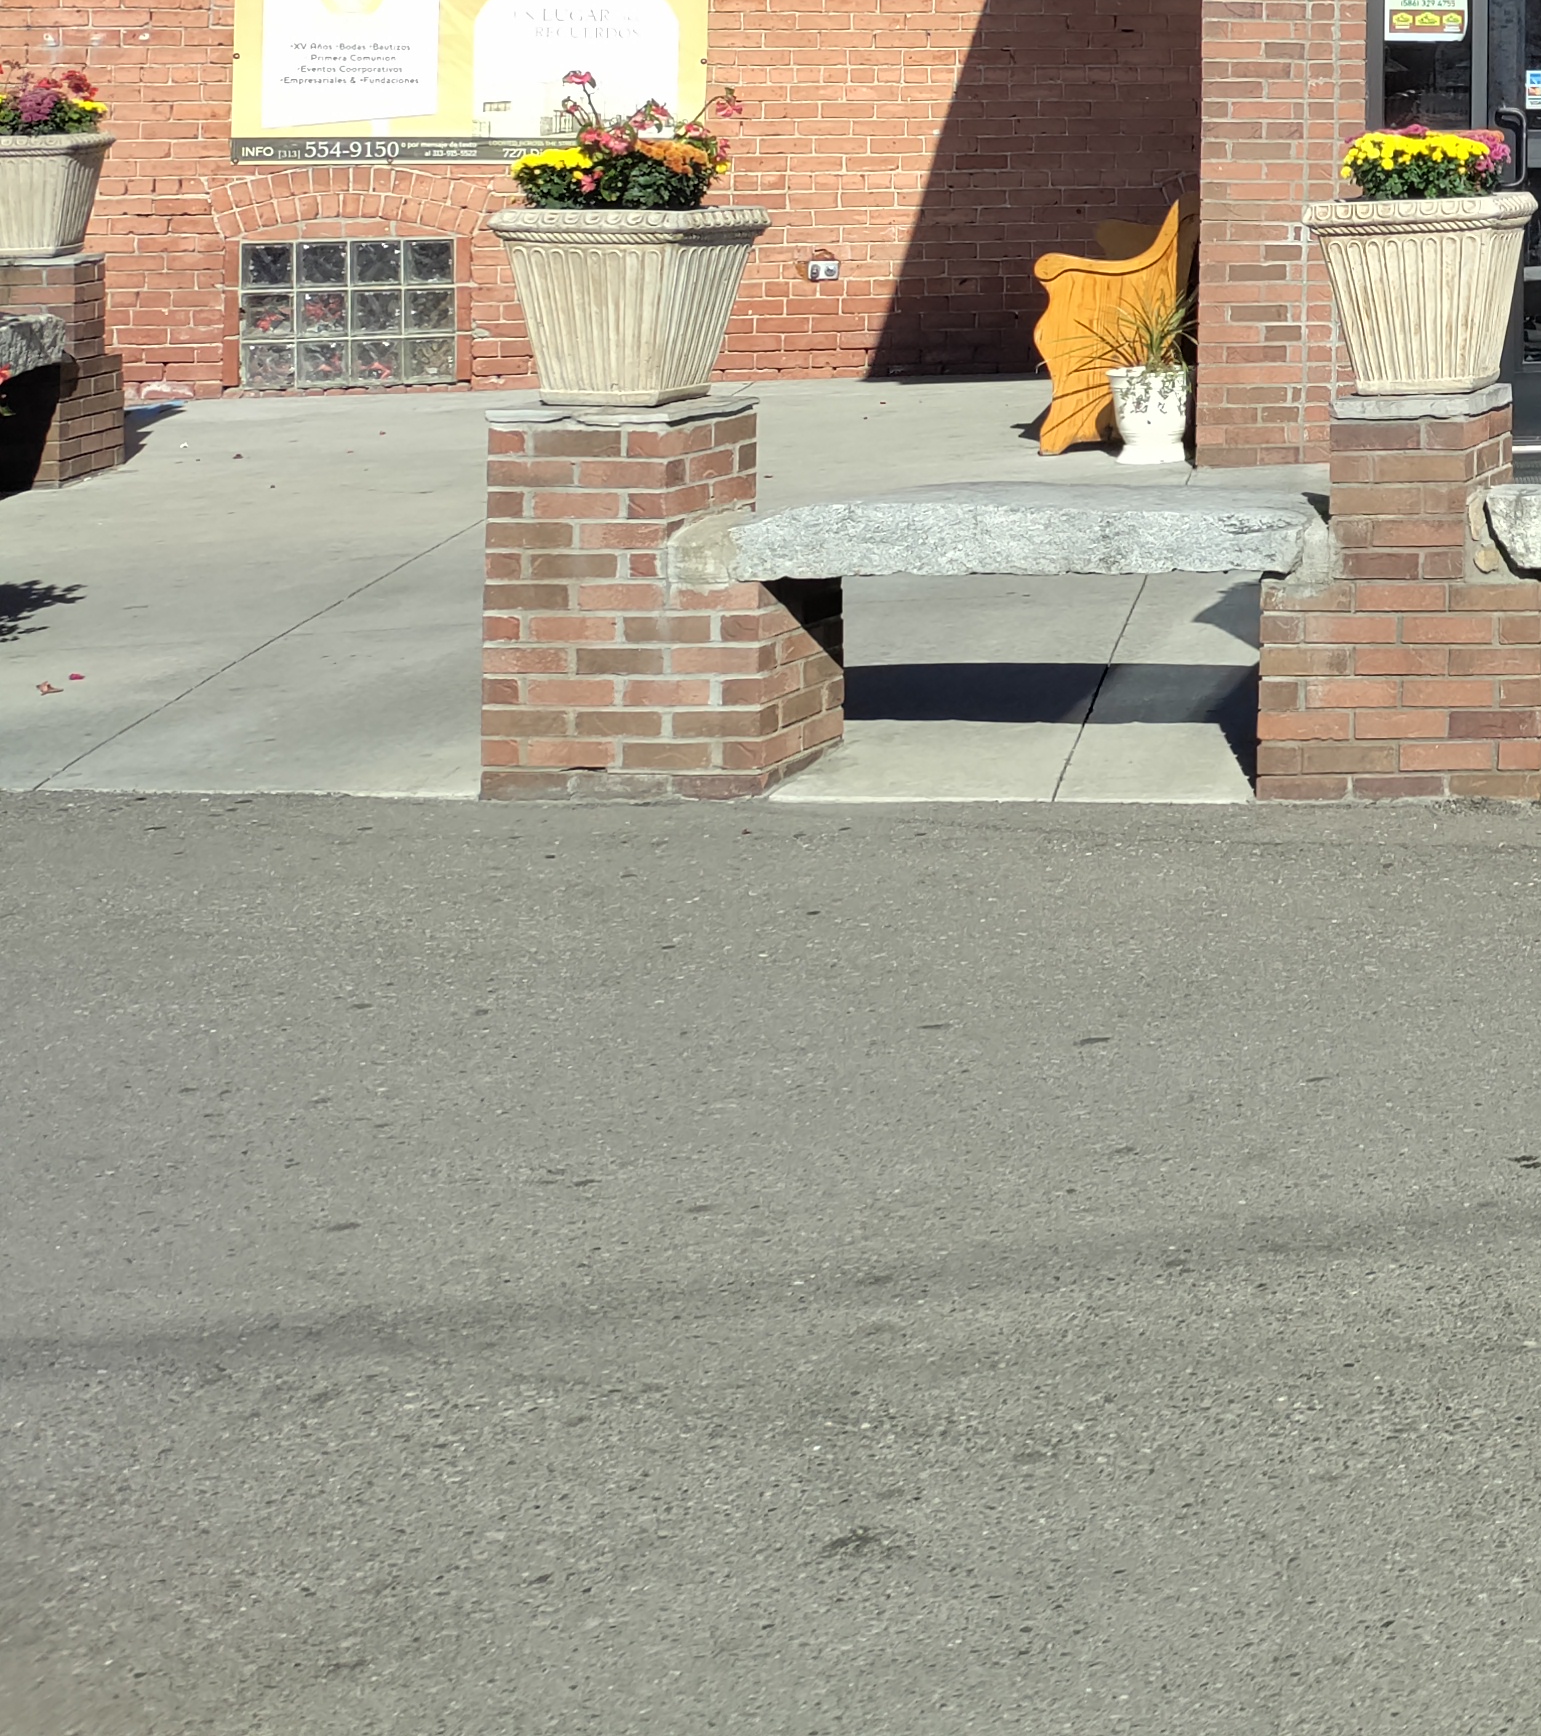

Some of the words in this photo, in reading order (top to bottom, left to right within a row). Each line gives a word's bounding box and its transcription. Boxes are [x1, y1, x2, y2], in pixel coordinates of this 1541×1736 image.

[339, 65, 402, 74] Coorporativos
[241, 146, 274, 157] INFO
[304, 141, 399, 158] 554-9150
